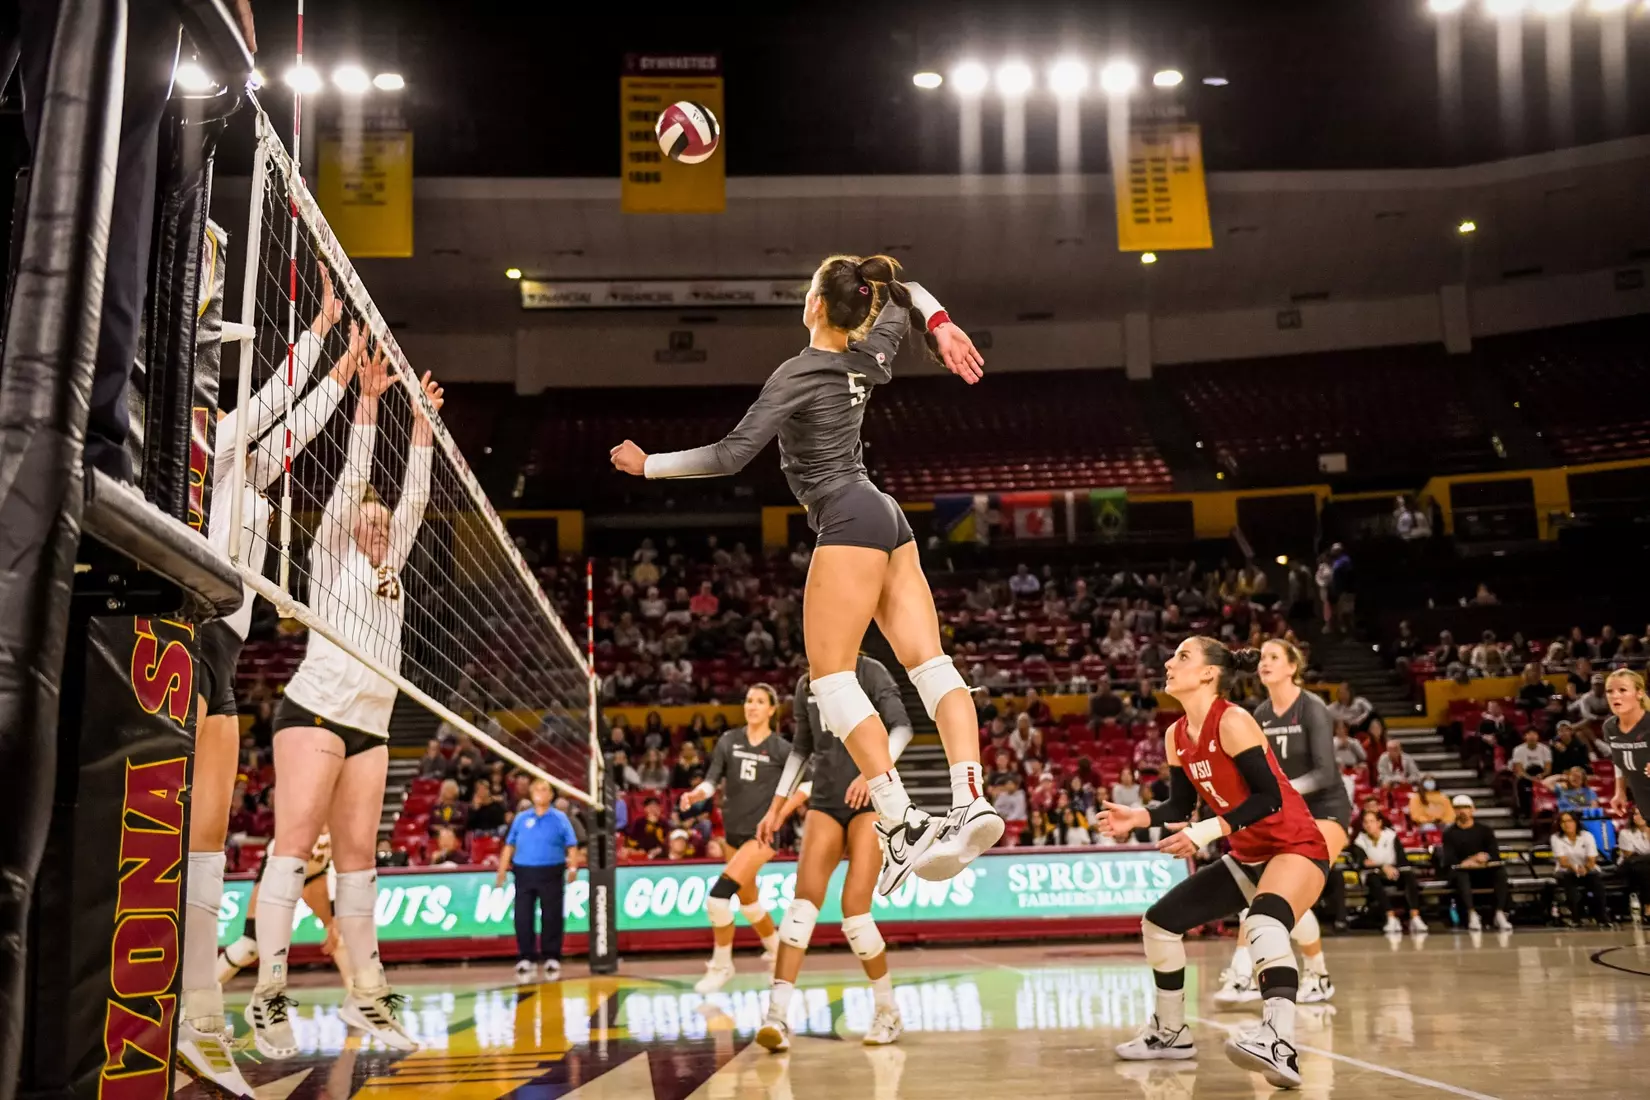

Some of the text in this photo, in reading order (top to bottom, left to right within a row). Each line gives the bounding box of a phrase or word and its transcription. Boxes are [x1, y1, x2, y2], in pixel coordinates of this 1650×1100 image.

[847, 372, 867, 407] 5
[1276, 735, 1288, 759] 7
[740, 758, 757, 781] 15
[1189, 759, 1213, 780] WSU
[1622, 750, 1637, 771] 11
[1008, 859, 1173, 893] SPROUTS
